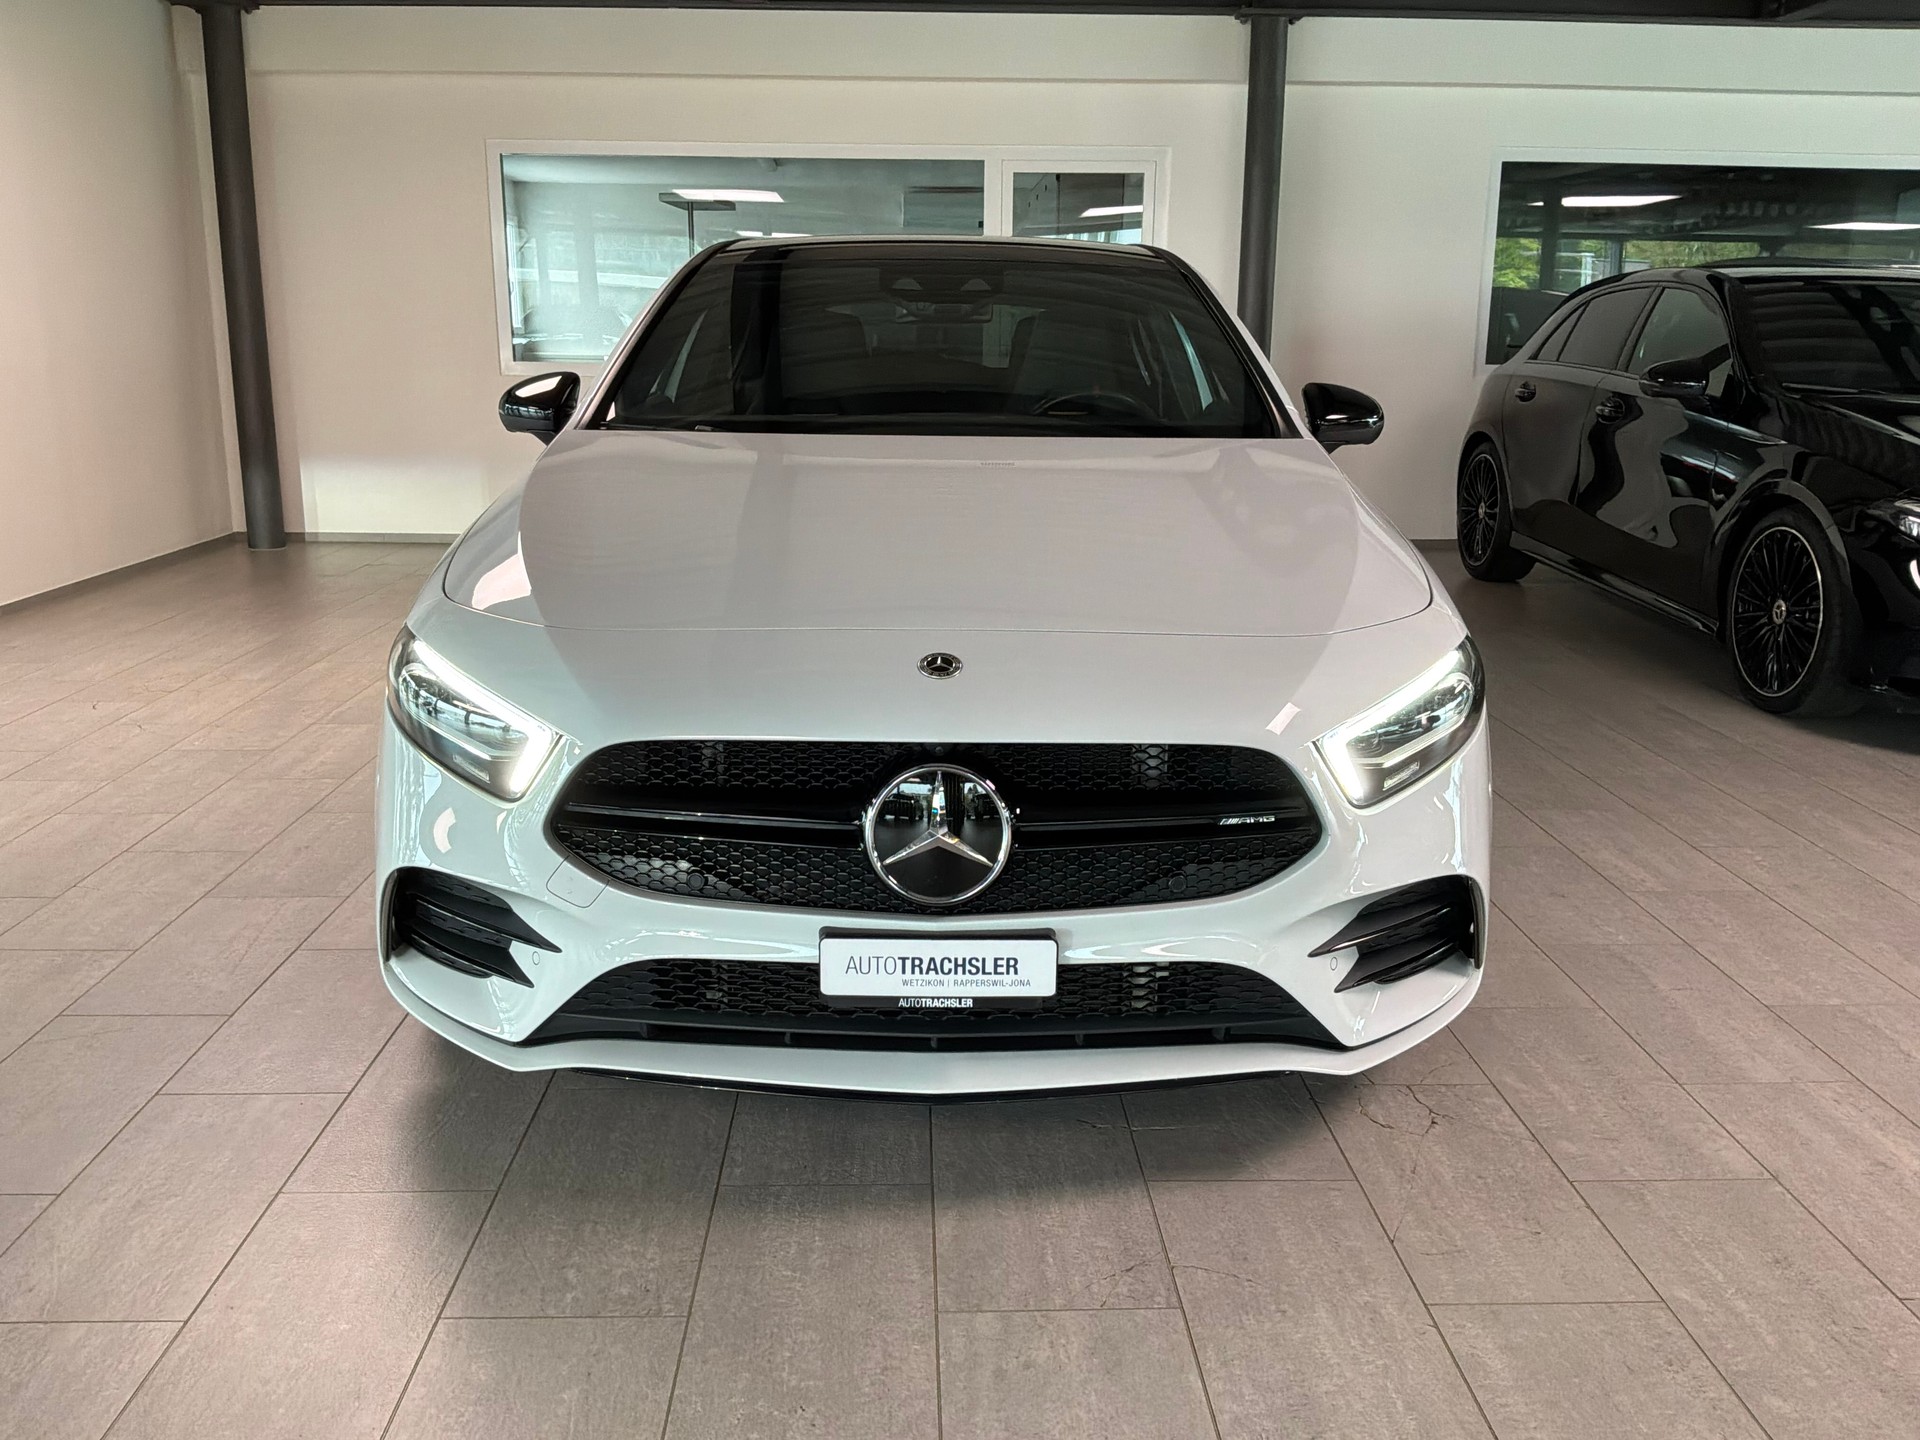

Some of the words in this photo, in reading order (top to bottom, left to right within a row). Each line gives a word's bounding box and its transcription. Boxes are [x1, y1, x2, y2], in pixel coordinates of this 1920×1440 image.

[1237, 816, 1276, 825] AMG
[845, 956, 1018, 975] AUTOTRACHSLER
[902, 979, 945, 987] WETZIKON
[953, 979, 1031, 987] RAPPERSWIL-JONA
[898, 998, 973, 1008] AUTOTRACHSLER
